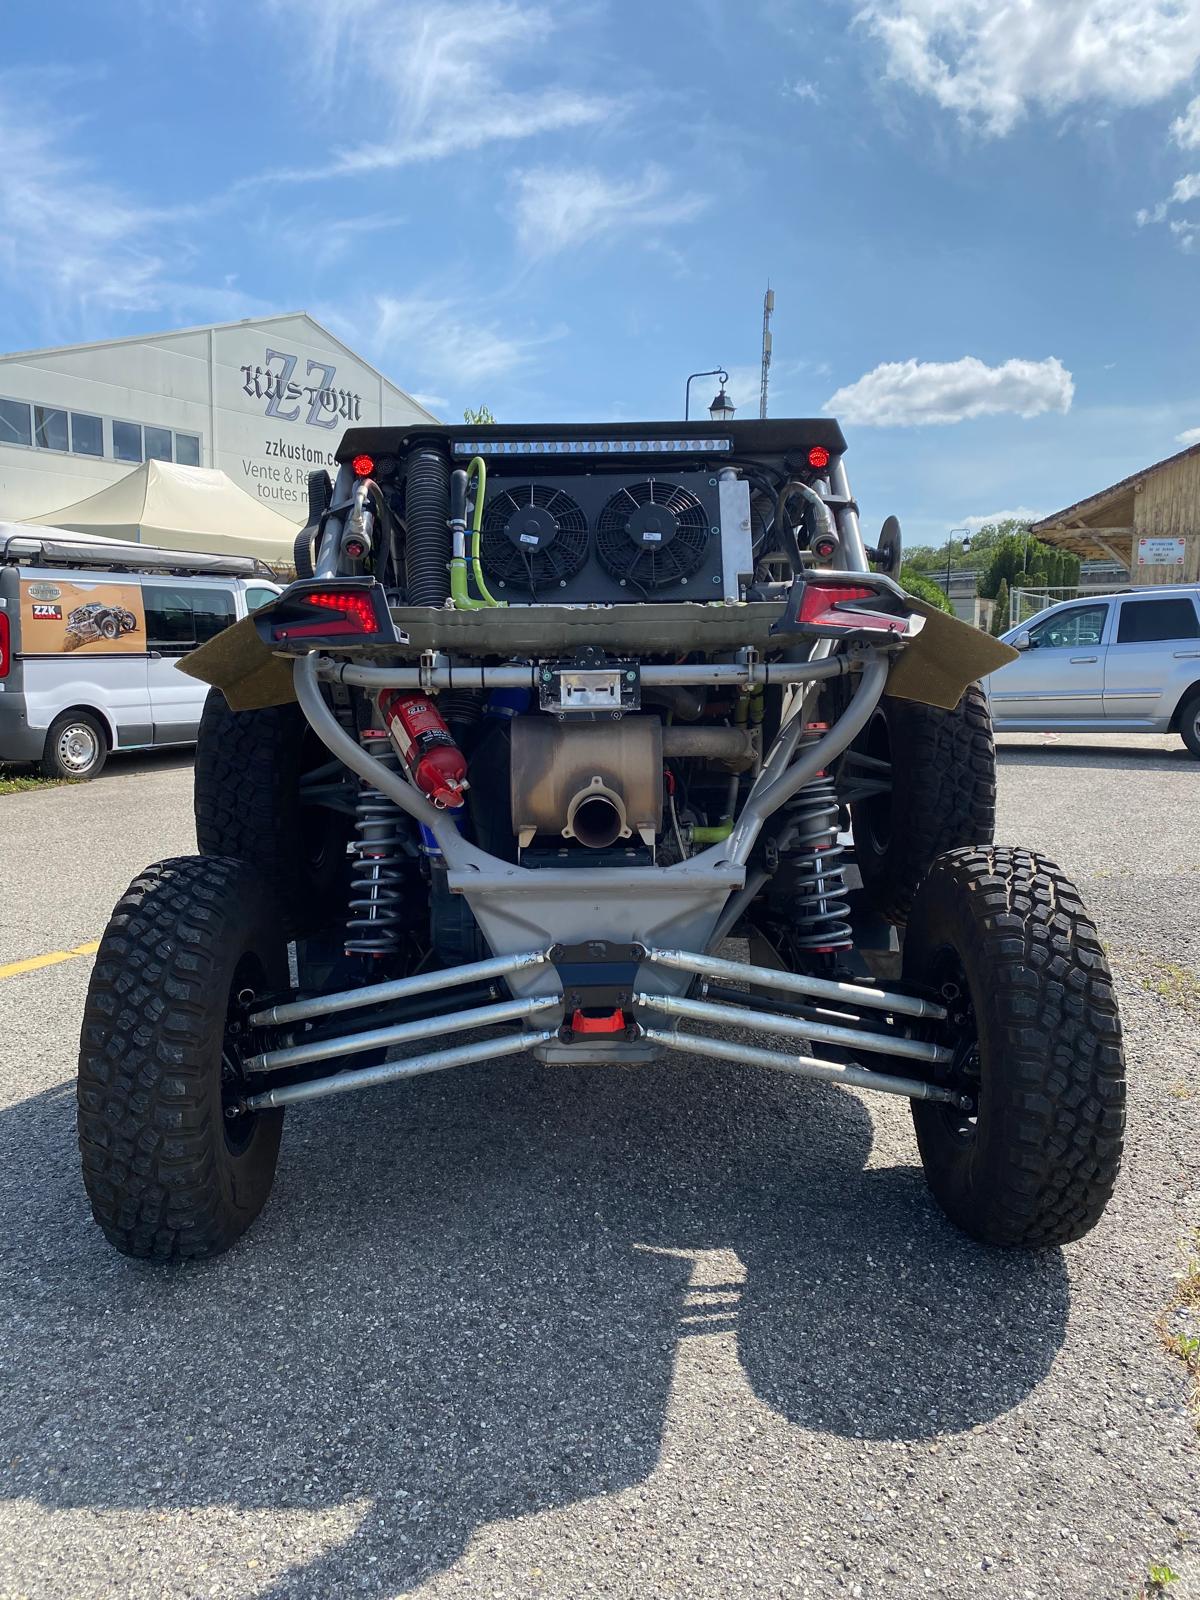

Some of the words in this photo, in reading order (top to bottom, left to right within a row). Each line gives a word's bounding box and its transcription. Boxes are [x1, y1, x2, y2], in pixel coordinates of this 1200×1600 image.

[242, 459, 280, 482] Vente
[283, 467, 292, 484] &
[257, 483, 297, 502] toutes
[33, 605, 55, 615] ZZK
